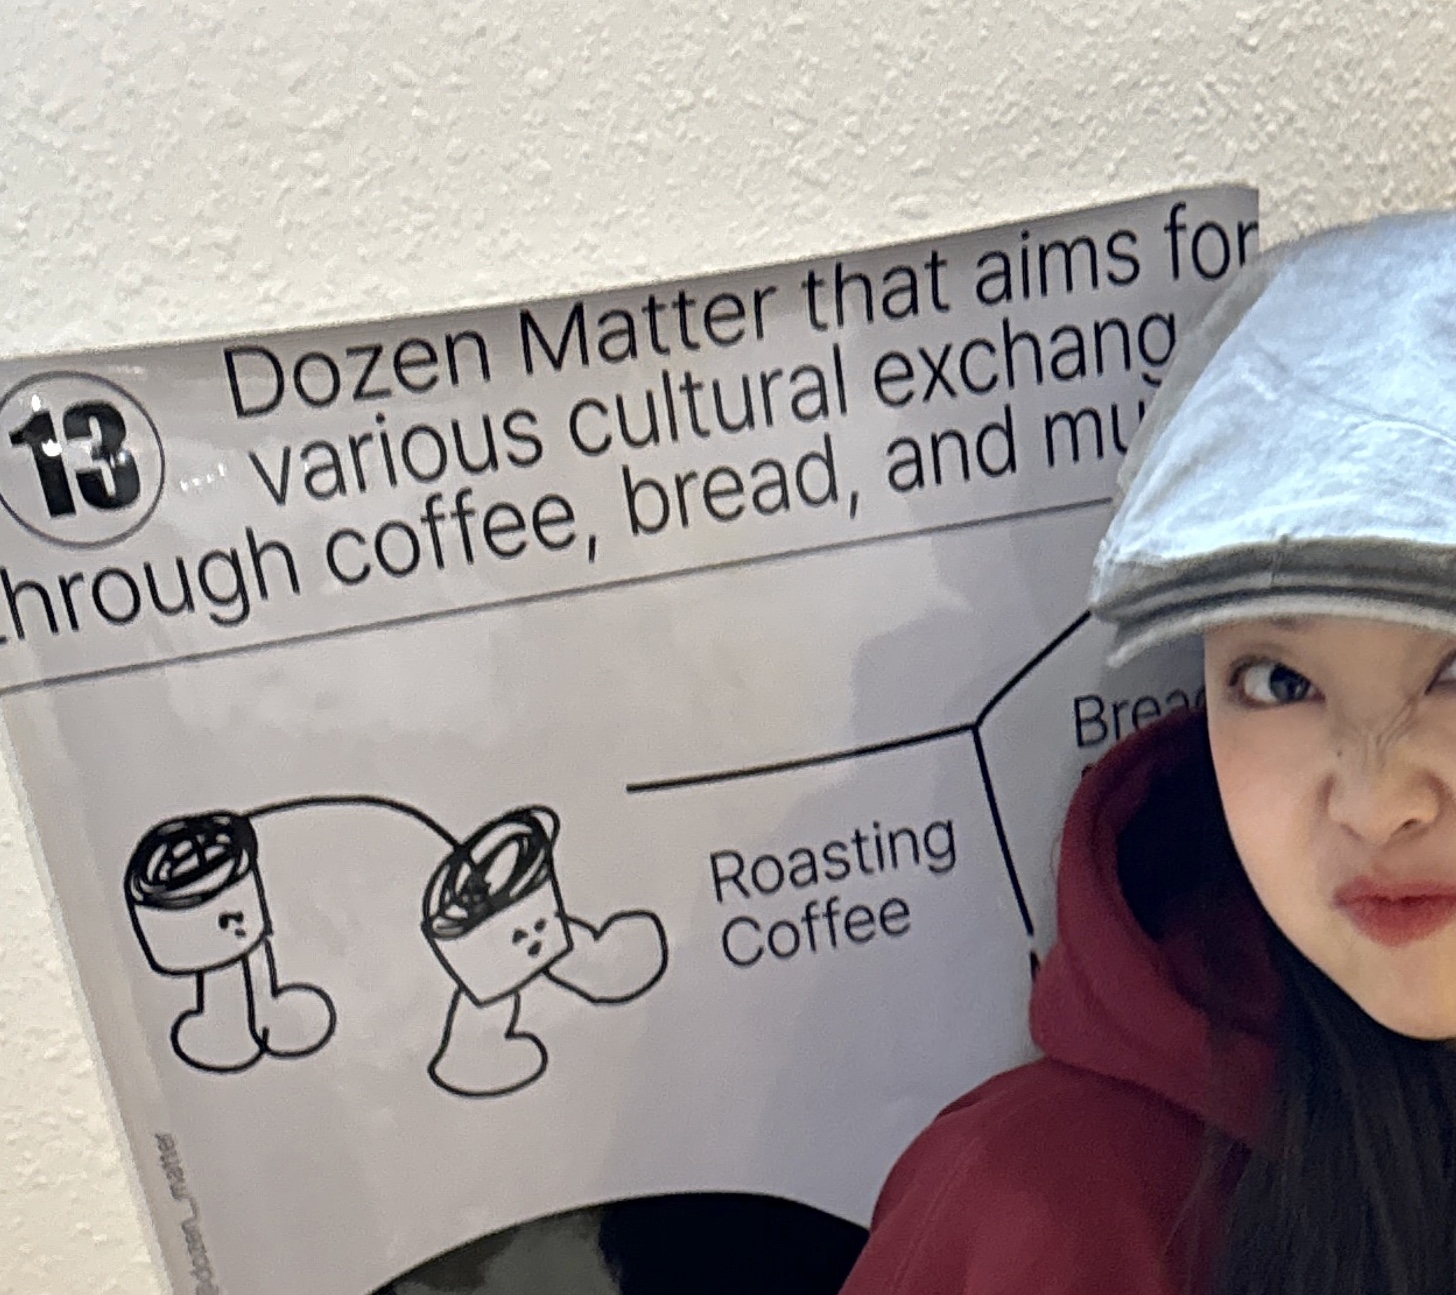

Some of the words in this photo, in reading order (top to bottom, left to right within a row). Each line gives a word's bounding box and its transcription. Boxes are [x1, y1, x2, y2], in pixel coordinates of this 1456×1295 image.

[223, 329, 491, 419] Dozen
[519, 283, 778, 375] Matter
[802, 249, 950, 332] that
[975, 231, 1141, 302] aims
[1163, 201, 1258, 281] for
[9, 400, 142, 519] 13
[250, 409, 544, 505] various
[568, 342, 847, 457] cultural
[0, 526, 301, 644] hrough
[325, 488, 597, 587] coffee,
[621, 432, 859, 537] bread,
[887, 403, 1017, 493] and
[709, 817, 957, 903] Roasting
[721, 896, 911, 967] Coffee
